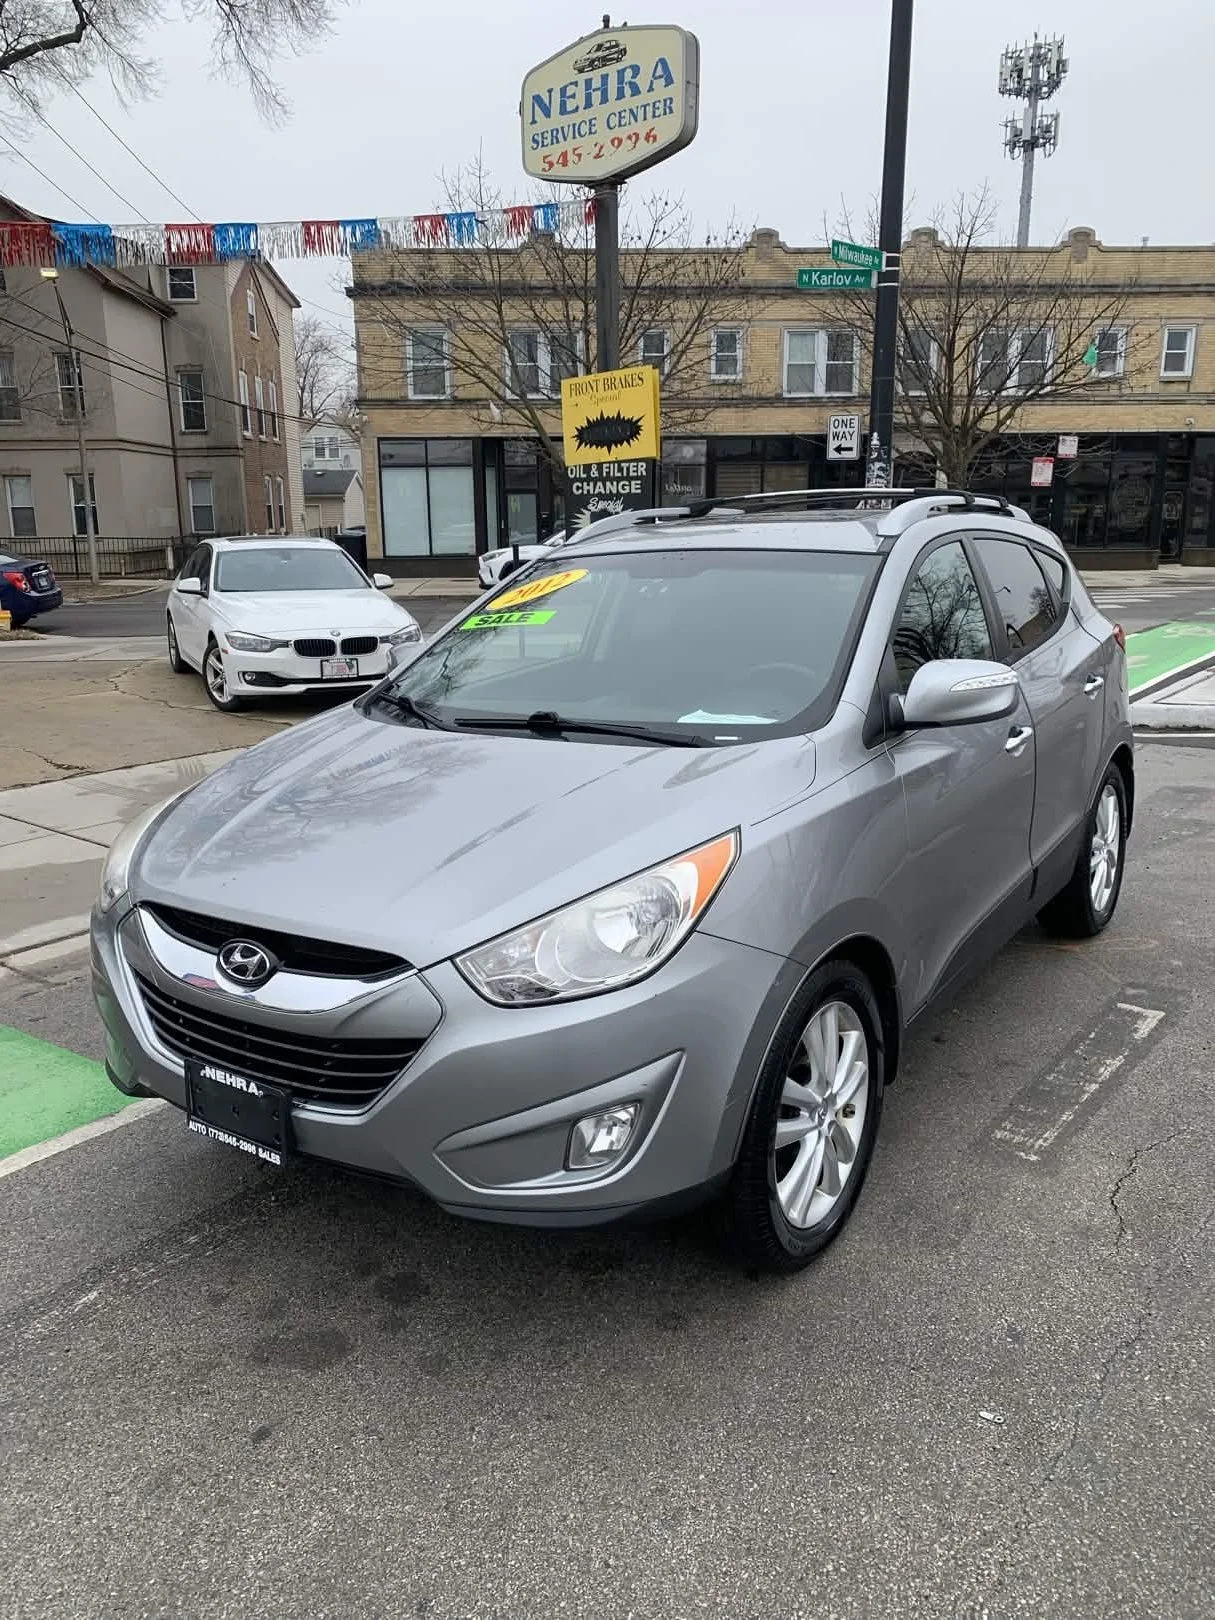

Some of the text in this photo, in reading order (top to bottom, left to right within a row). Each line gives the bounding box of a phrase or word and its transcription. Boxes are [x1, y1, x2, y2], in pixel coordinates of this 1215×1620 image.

[529, 57, 675, 125] NEHRA
[530, 97, 675, 151] SERVICE CENTER
[541, 127, 659, 173] 545-2996
[838, 243, 873, 267] Milwaukee
[802, 271, 865, 286] N Karlov Av
[569, 371, 645, 398] FRONT BRAKES
[832, 417, 856, 429] ONE
[832, 431, 856, 442] WAY
[567, 461, 647, 479] OIL & FILTER
[572, 480, 642, 495] CHANGE
[587, 496, 624, 514] Special
[503, 573, 571, 604] 2012
[474, 613, 535, 626] SALE
[204, 1066, 260, 1096] NEHRA
[188, 1120, 207, 1135] AUTO
[258, 1147, 281, 1165] SALES
